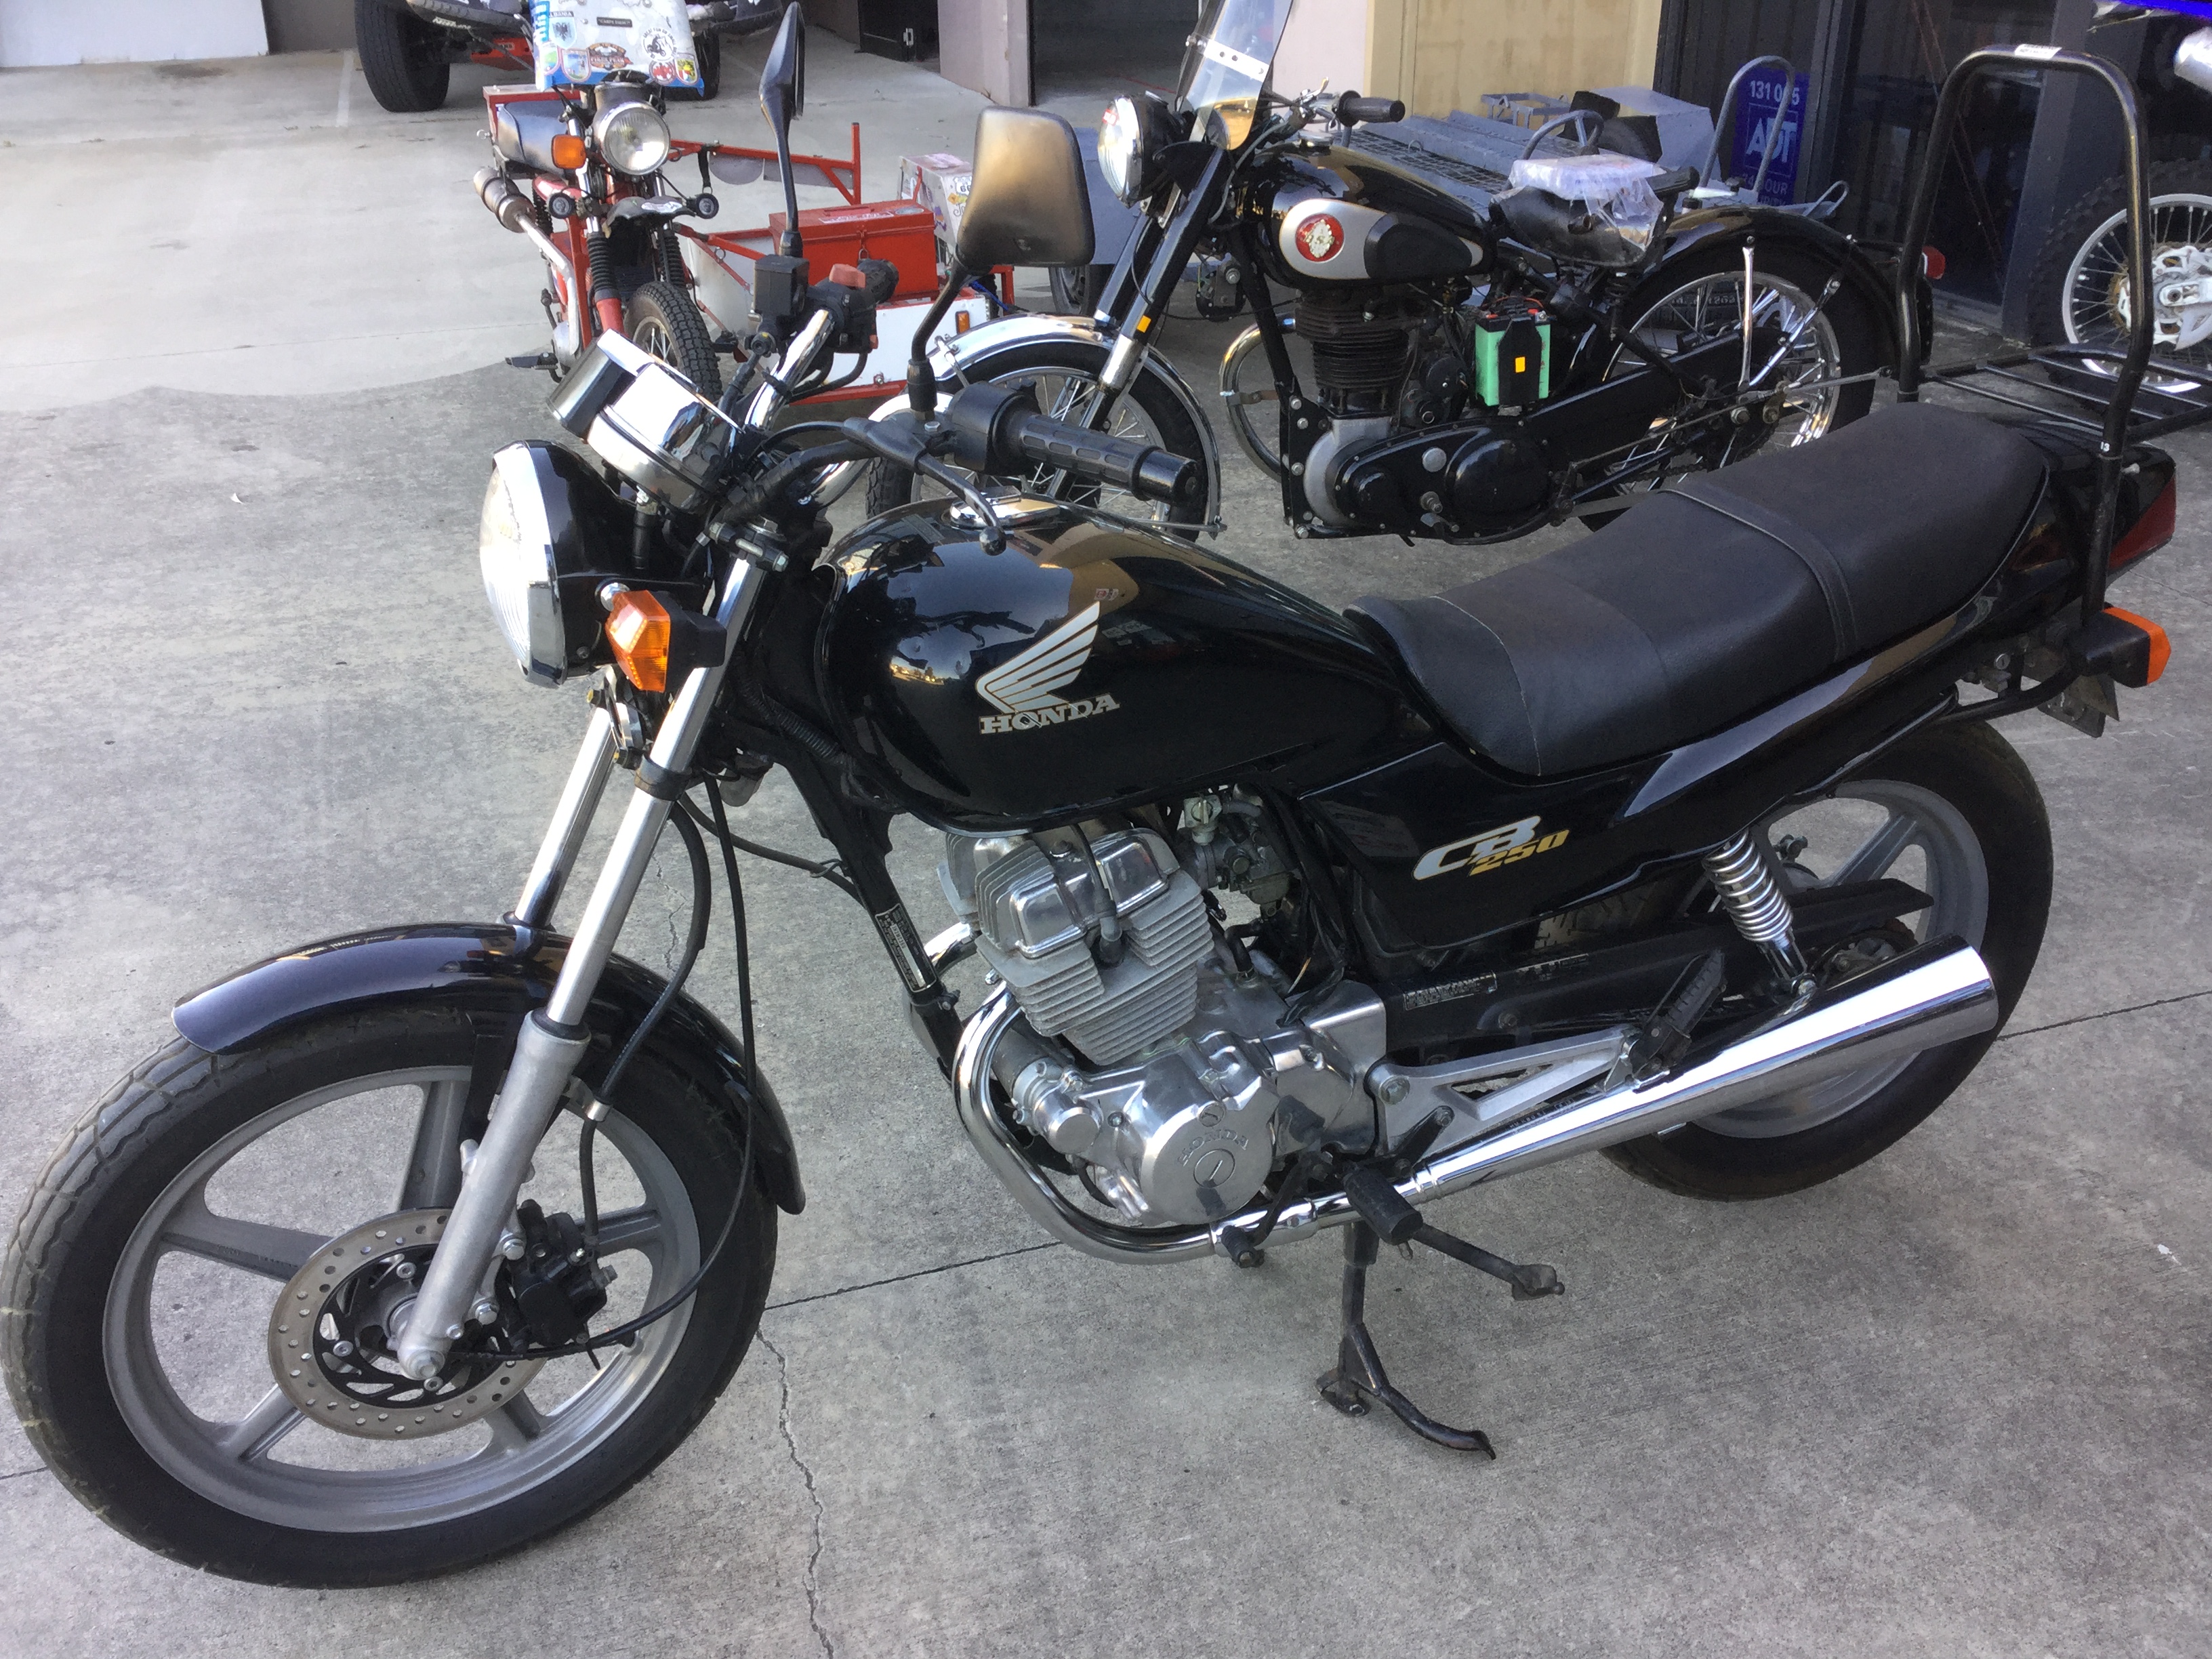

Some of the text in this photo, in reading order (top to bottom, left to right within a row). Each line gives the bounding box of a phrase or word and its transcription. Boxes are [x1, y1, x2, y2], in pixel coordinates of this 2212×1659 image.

[1750, 81, 1800, 106] 131 05
[1746, 117, 1797, 163] ADT
[1765, 179, 1788, 194] OUR
[980, 693, 1120, 735] HONDA
[1412, 815, 1570, 881] CB 250
[1176, 1128, 1250, 1167] HONDA
